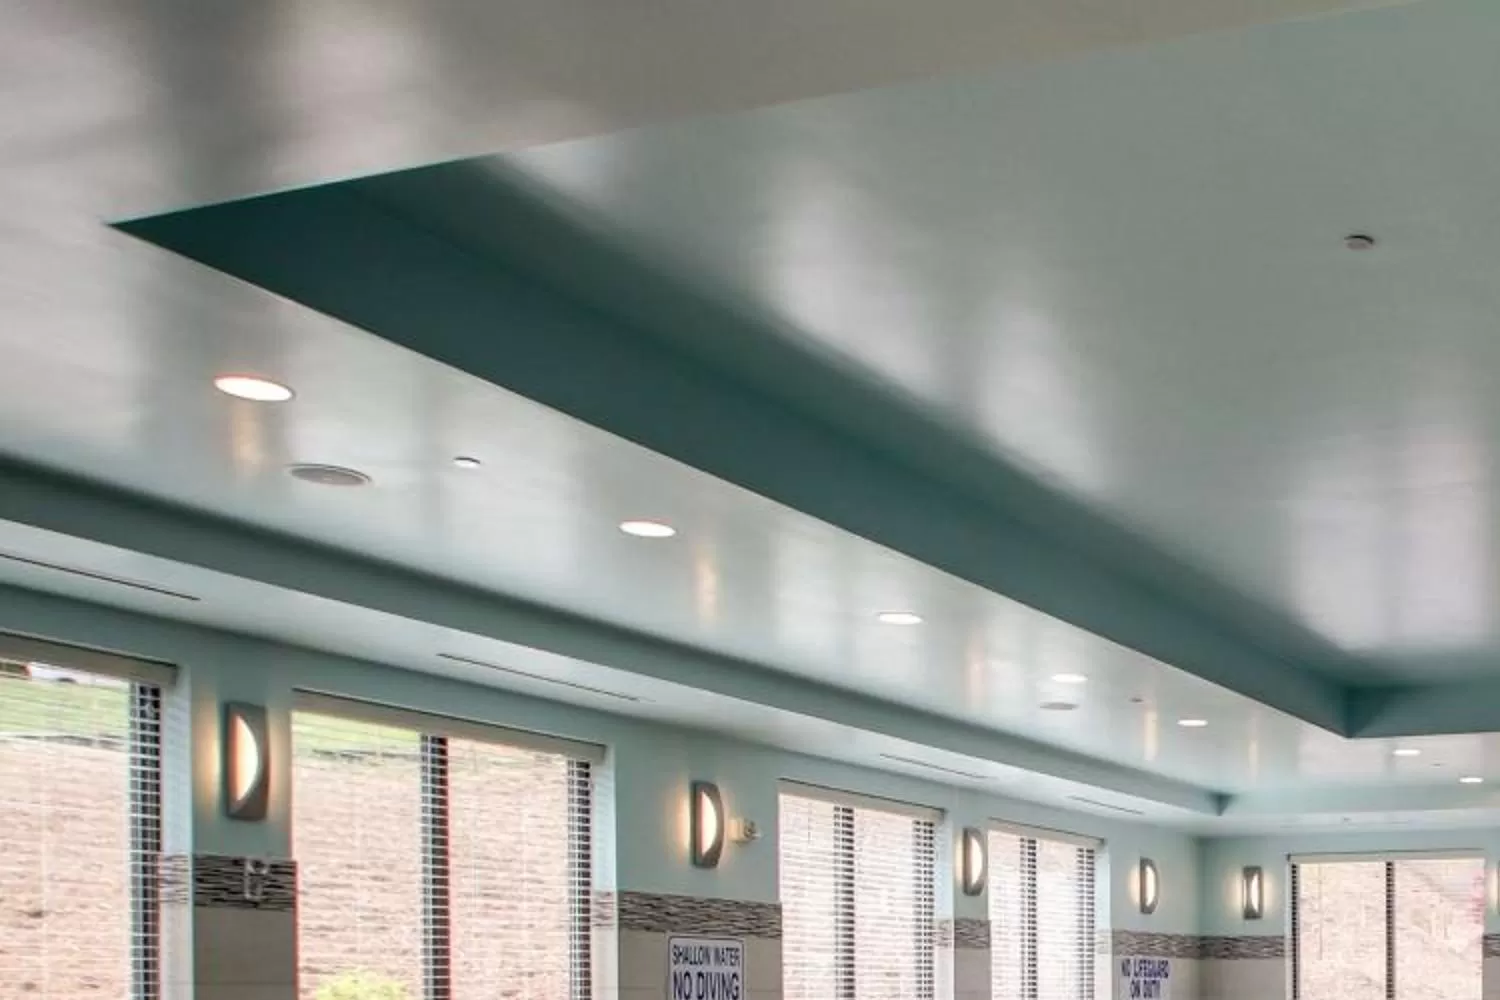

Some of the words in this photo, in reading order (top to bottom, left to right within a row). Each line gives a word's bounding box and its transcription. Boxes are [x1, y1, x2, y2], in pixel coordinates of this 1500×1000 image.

[672, 945, 710, 965] SHALLOW
[713, 947, 740, 966] WATER
[673, 971, 692, 1000] NO
[696, 972, 739, 1000] DIVING
